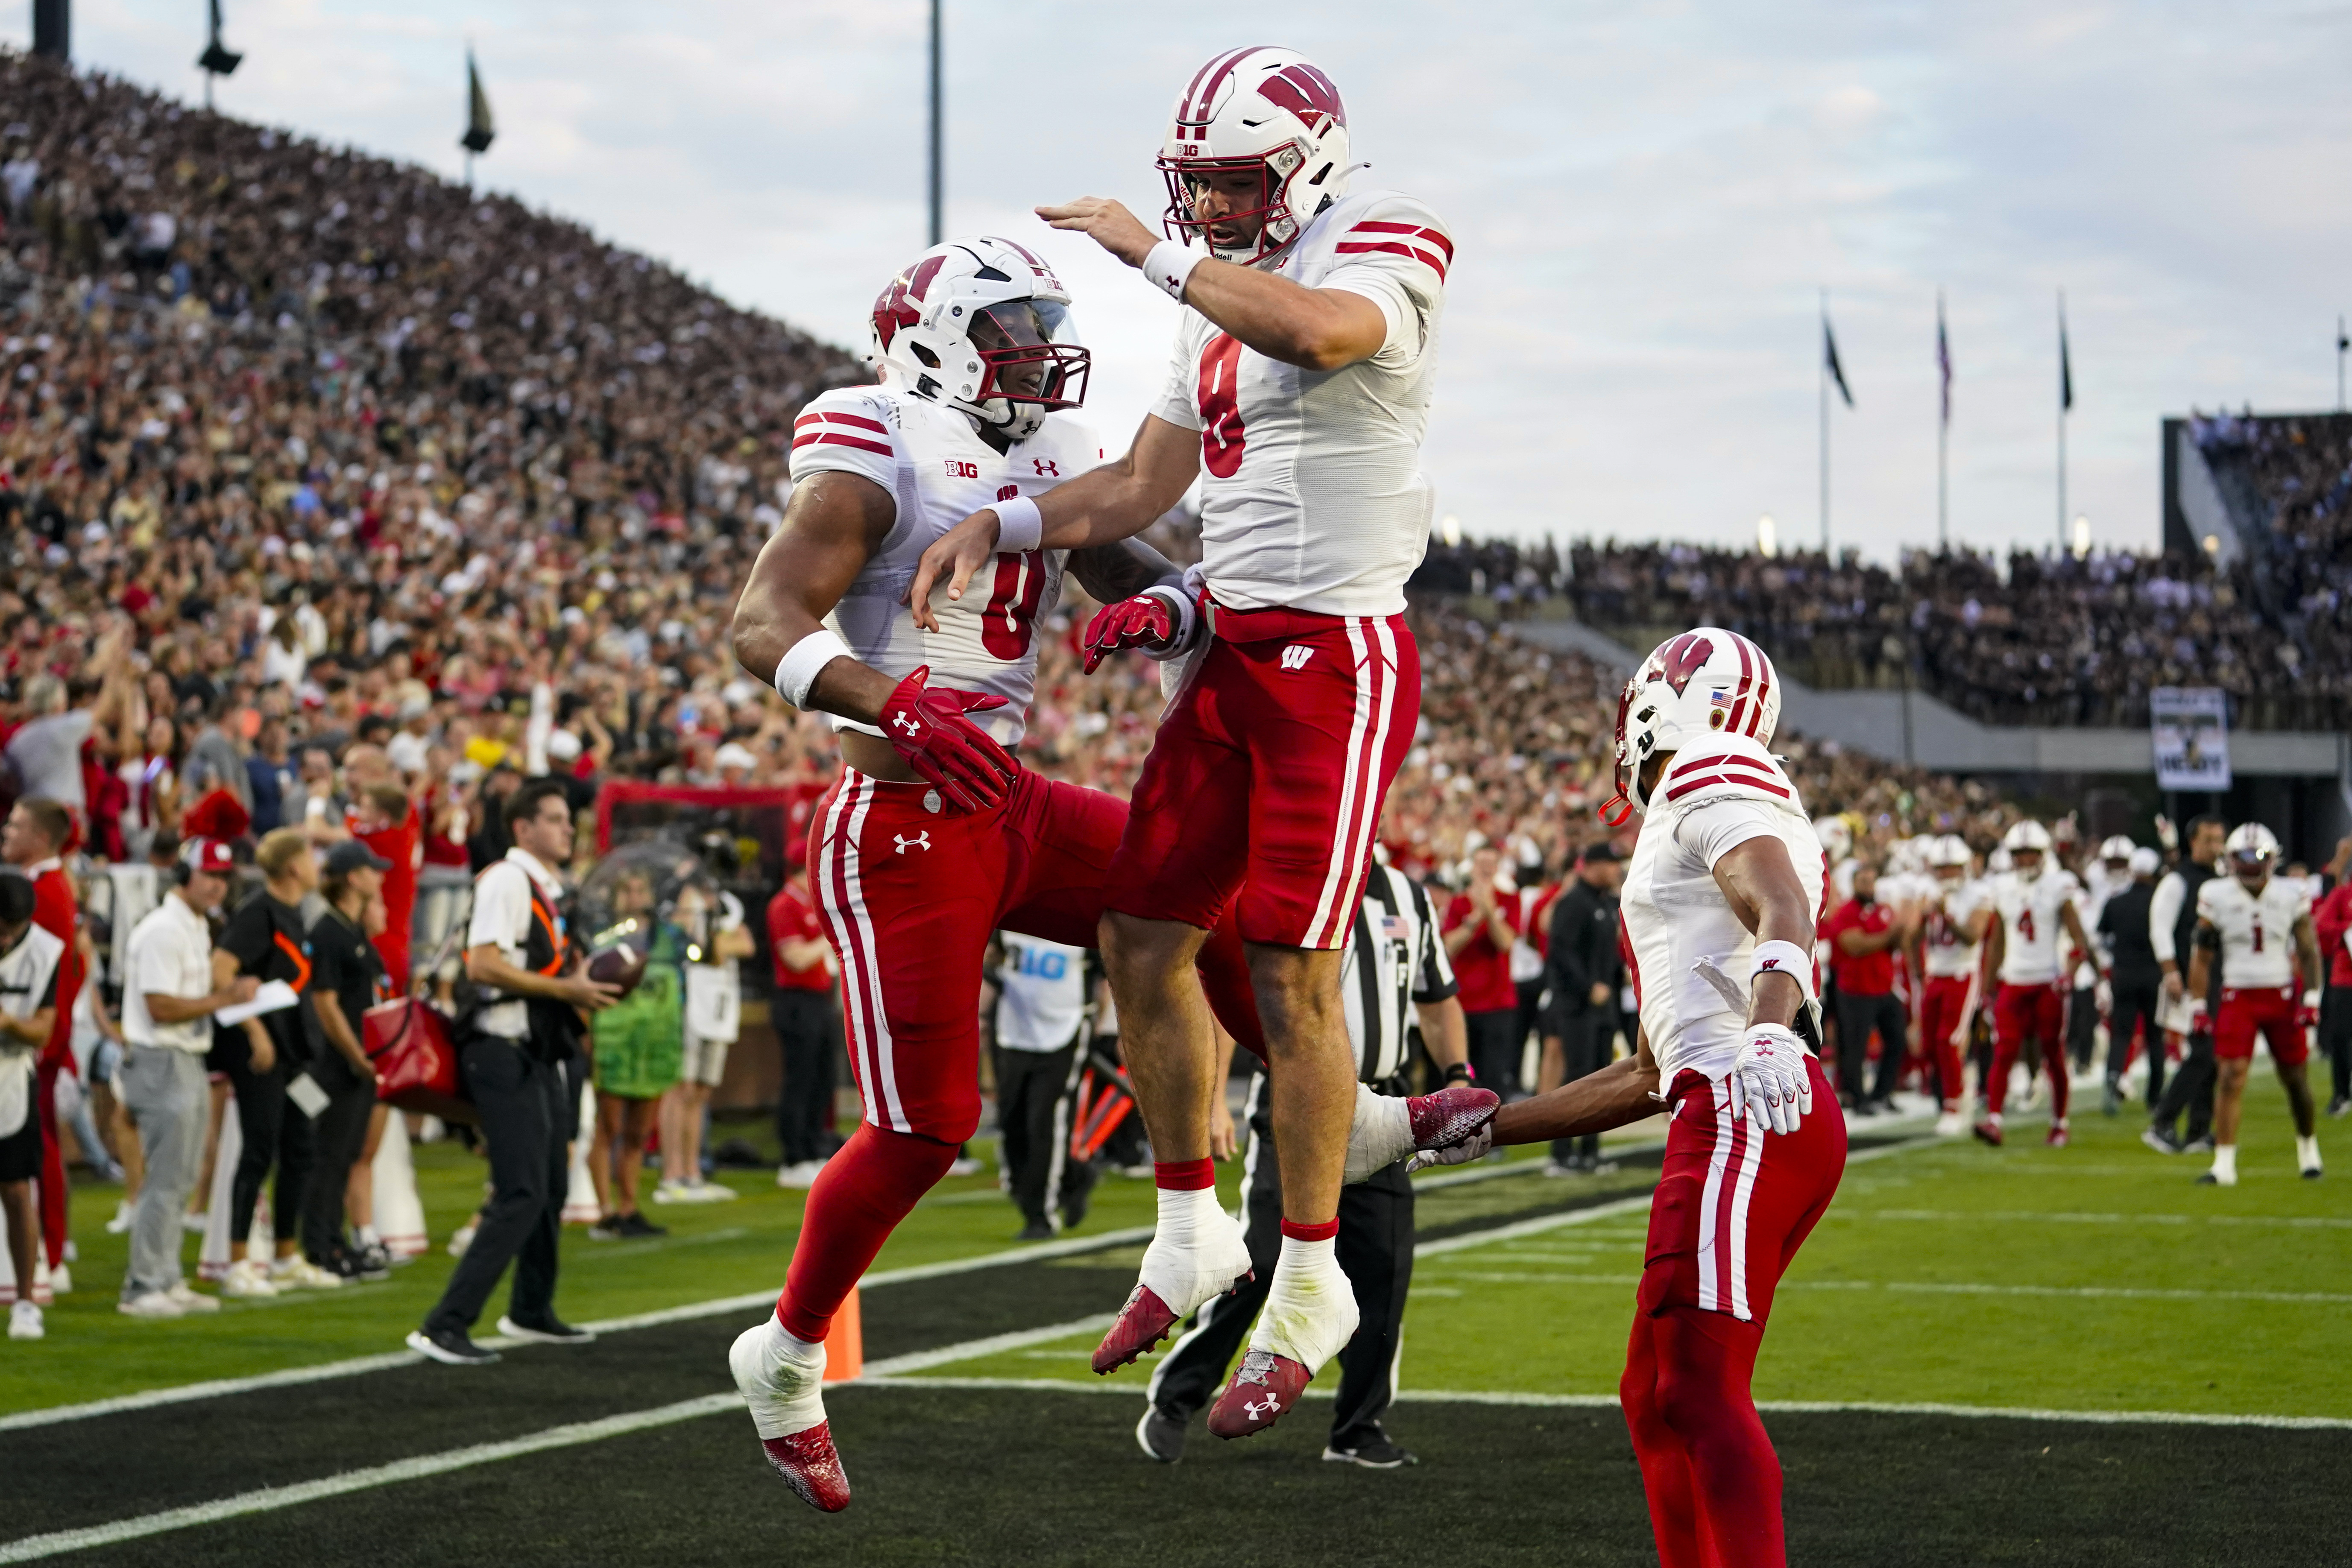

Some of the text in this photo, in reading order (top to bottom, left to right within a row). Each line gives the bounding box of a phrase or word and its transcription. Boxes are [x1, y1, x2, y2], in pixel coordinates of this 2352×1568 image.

[1214, 253, 1233, 261] ddell
[1198, 331, 1246, 479] 8
[1281, 645, 1315, 670] W
[2017, 908, 2035, 942] 4
[2252, 924, 2264, 953] 1
[1762, 959, 1780, 972] W
